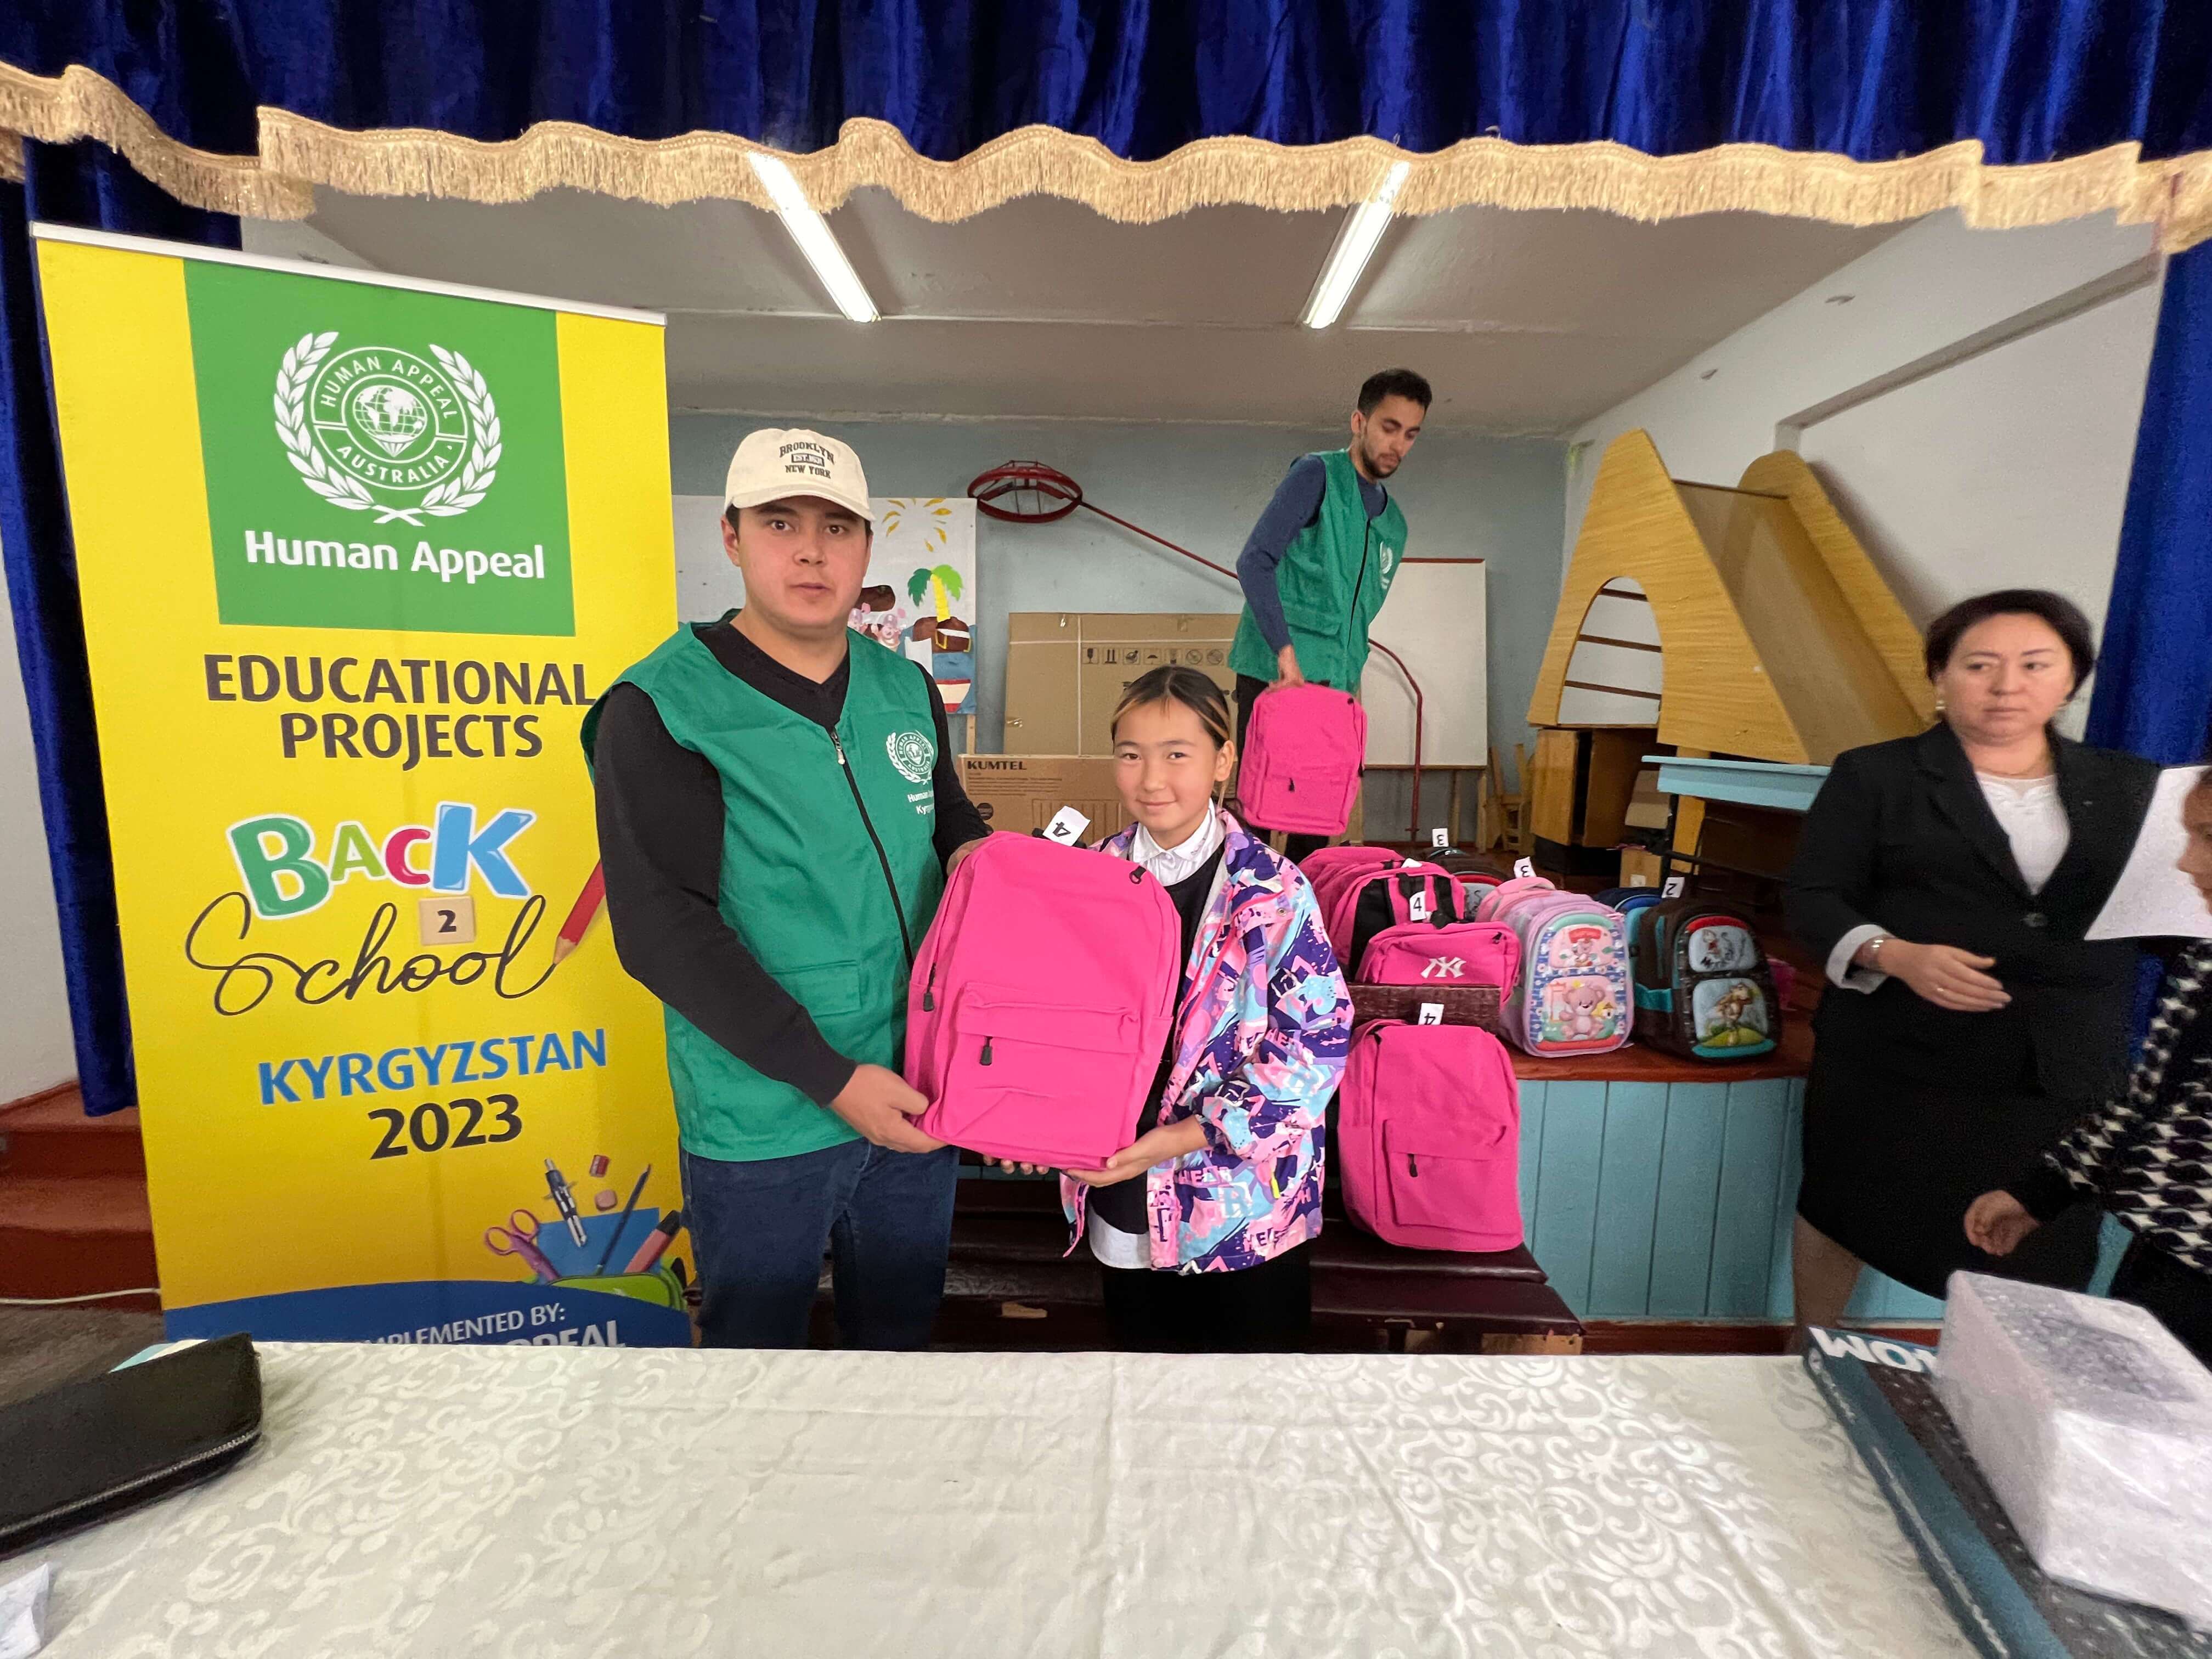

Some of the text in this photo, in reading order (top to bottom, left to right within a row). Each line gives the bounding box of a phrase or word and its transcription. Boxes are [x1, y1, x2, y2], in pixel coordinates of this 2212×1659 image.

[320, 355, 458, 419] HUMAN APPEAL
[337, 445, 450, 483] AUSTRALIA
[779, 441, 835, 465] BROOKLYN
[785, 465, 831, 479] NEW YORK
[245, 530, 545, 584] Human Appeal
[204, 653, 596, 706] EDUCATIONAL
[280, 712, 542, 771] PROJECTS
[967, 760, 1028, 770] KUMTEL
[1052, 821, 1071, 837] 4
[1666, 883, 1678, 895] 2
[1413, 897, 1422, 912] 4
[437, 909, 457, 933] 2
[185, 891, 556, 1016] School
[1424, 1012, 1436, 1025] 4
[258, 1028, 606, 1105] KYRGYZSTAN
[368, 1094, 522, 1160] 2023
[531, 1302, 566, 1327] BY:
